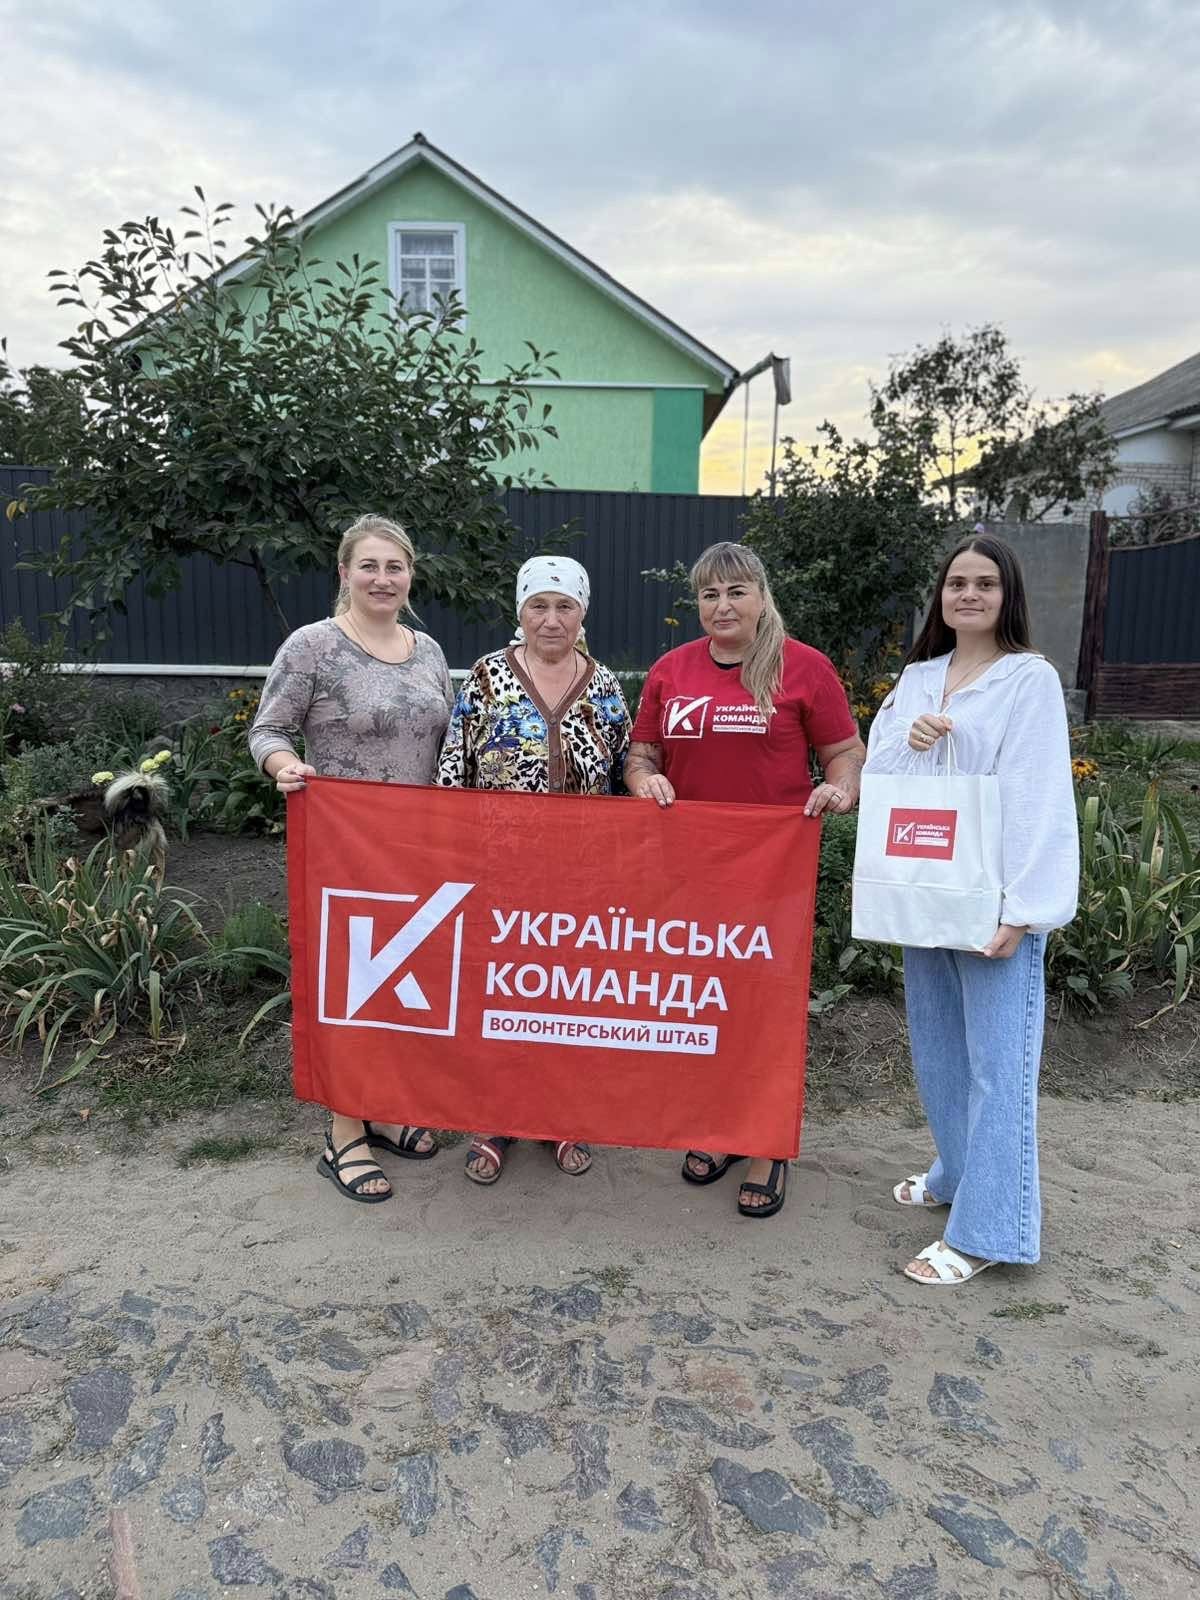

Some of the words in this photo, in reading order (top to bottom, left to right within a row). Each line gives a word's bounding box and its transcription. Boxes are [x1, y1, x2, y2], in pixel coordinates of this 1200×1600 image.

[715, 704, 777, 714] УКРАЇНСА
[490, 906, 774, 961] УКРАЇНСЬКА
[485, 962, 729, 1018] КОМАНДА
[490, 1017, 651, 1043] ВОЛОНТЕРСЬКИЙ
[656, 1029, 709, 1046] ШТАБ
